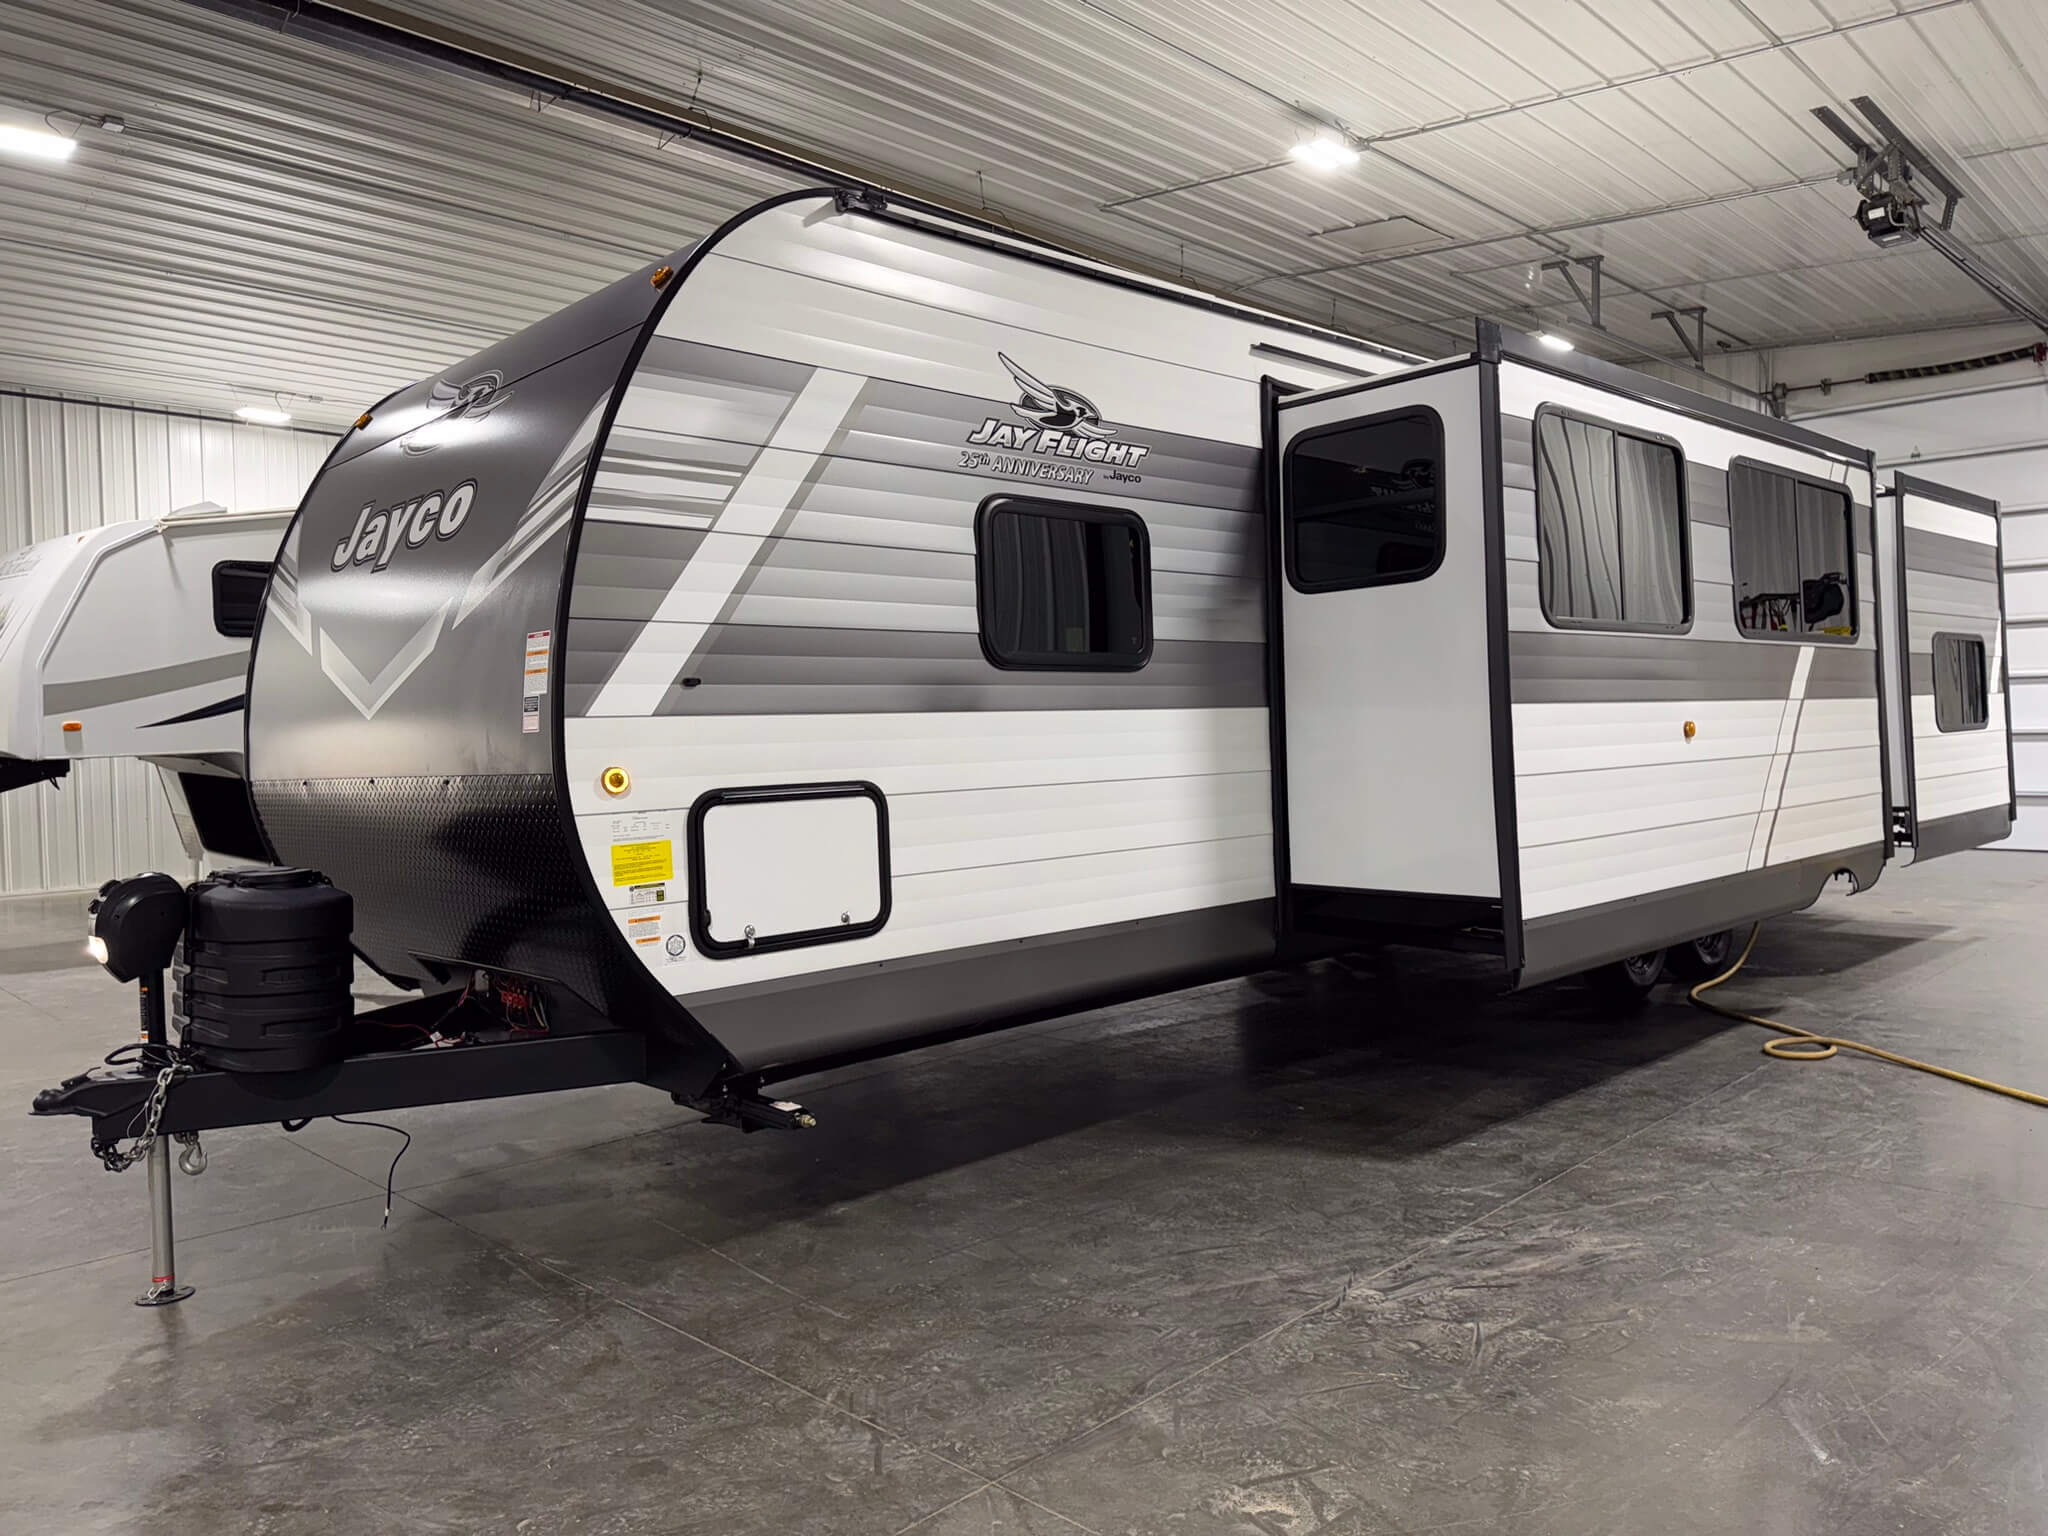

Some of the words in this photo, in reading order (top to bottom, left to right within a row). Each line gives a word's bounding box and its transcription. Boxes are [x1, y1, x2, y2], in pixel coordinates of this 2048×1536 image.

[968, 418, 1037, 450] JAY
[1034, 430, 1150, 468] FLIGHT
[958, 450, 990, 469] 25th
[992, 455, 1095, 485] ANNIVERSARY
[1109, 470, 1142, 484] Jayco
[331, 478, 478, 574] Jayco
